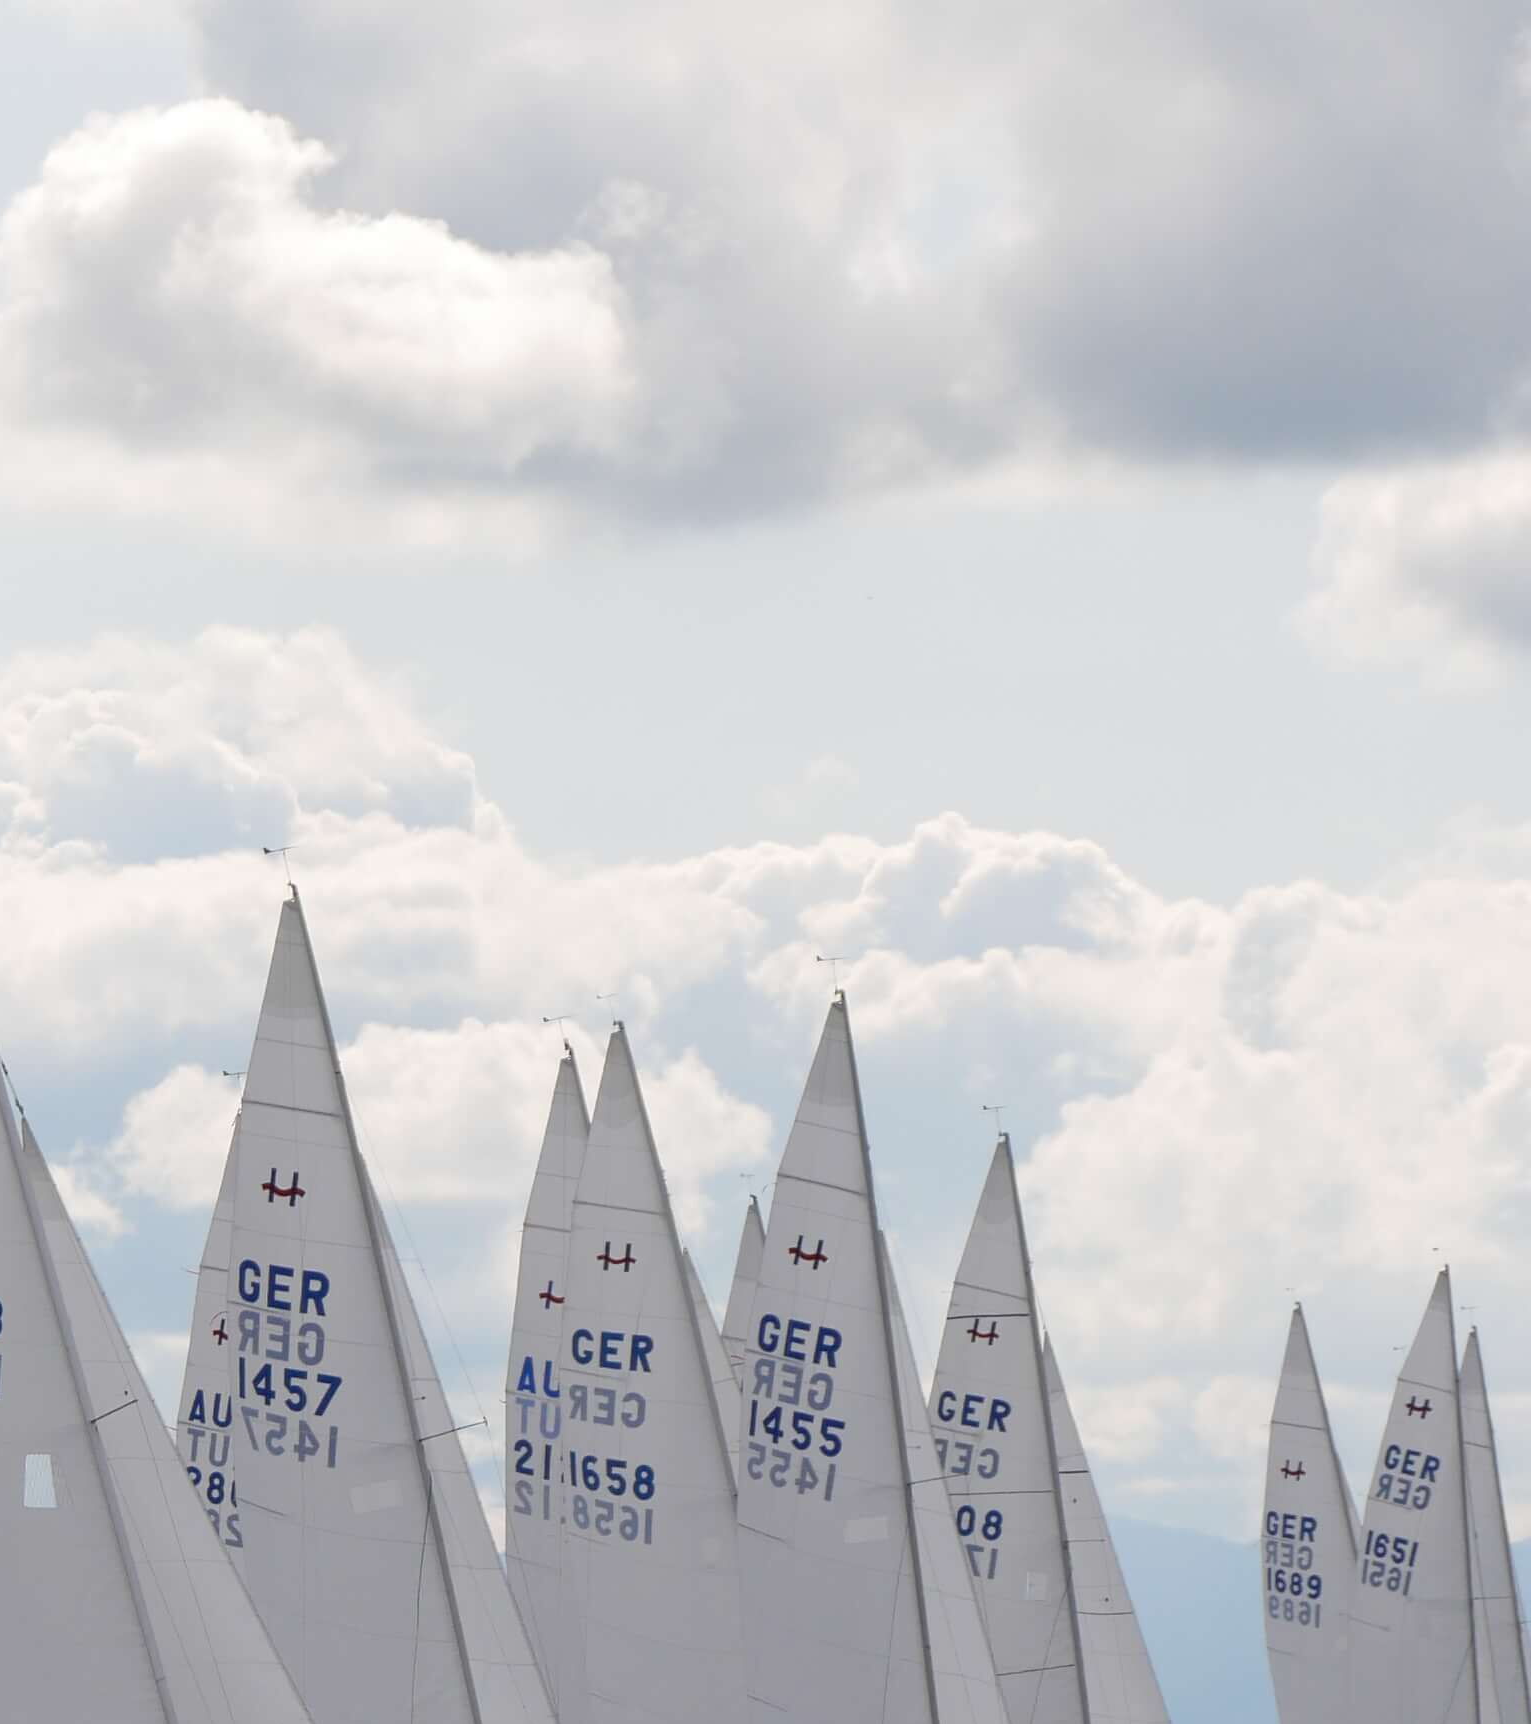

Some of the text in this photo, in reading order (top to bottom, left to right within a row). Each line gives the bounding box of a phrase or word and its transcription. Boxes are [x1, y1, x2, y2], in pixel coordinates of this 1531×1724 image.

[239, 1260, 329, 1316] GER
[572, 1329, 653, 1372] GER
[758, 1314, 841, 1367] GER
[239, 1357, 342, 1416] 1457
[518, 1357, 560, 1398] AU
[189, 1390, 232, 1427] AU
[749, 1400, 845, 1457] 1455
[938, 1391, 1011, 1432] GER
[514, 1440, 564, 1483] 21
[570, 1451, 654, 1500] 1658
[1385, 1445, 1440, 1482] GER
[955, 1505, 1002, 1540] 08
[1266, 1511, 1317, 1543] GER
[1365, 1530, 1418, 1567] 1651
[1267, 1567, 1321, 1599] 1689
